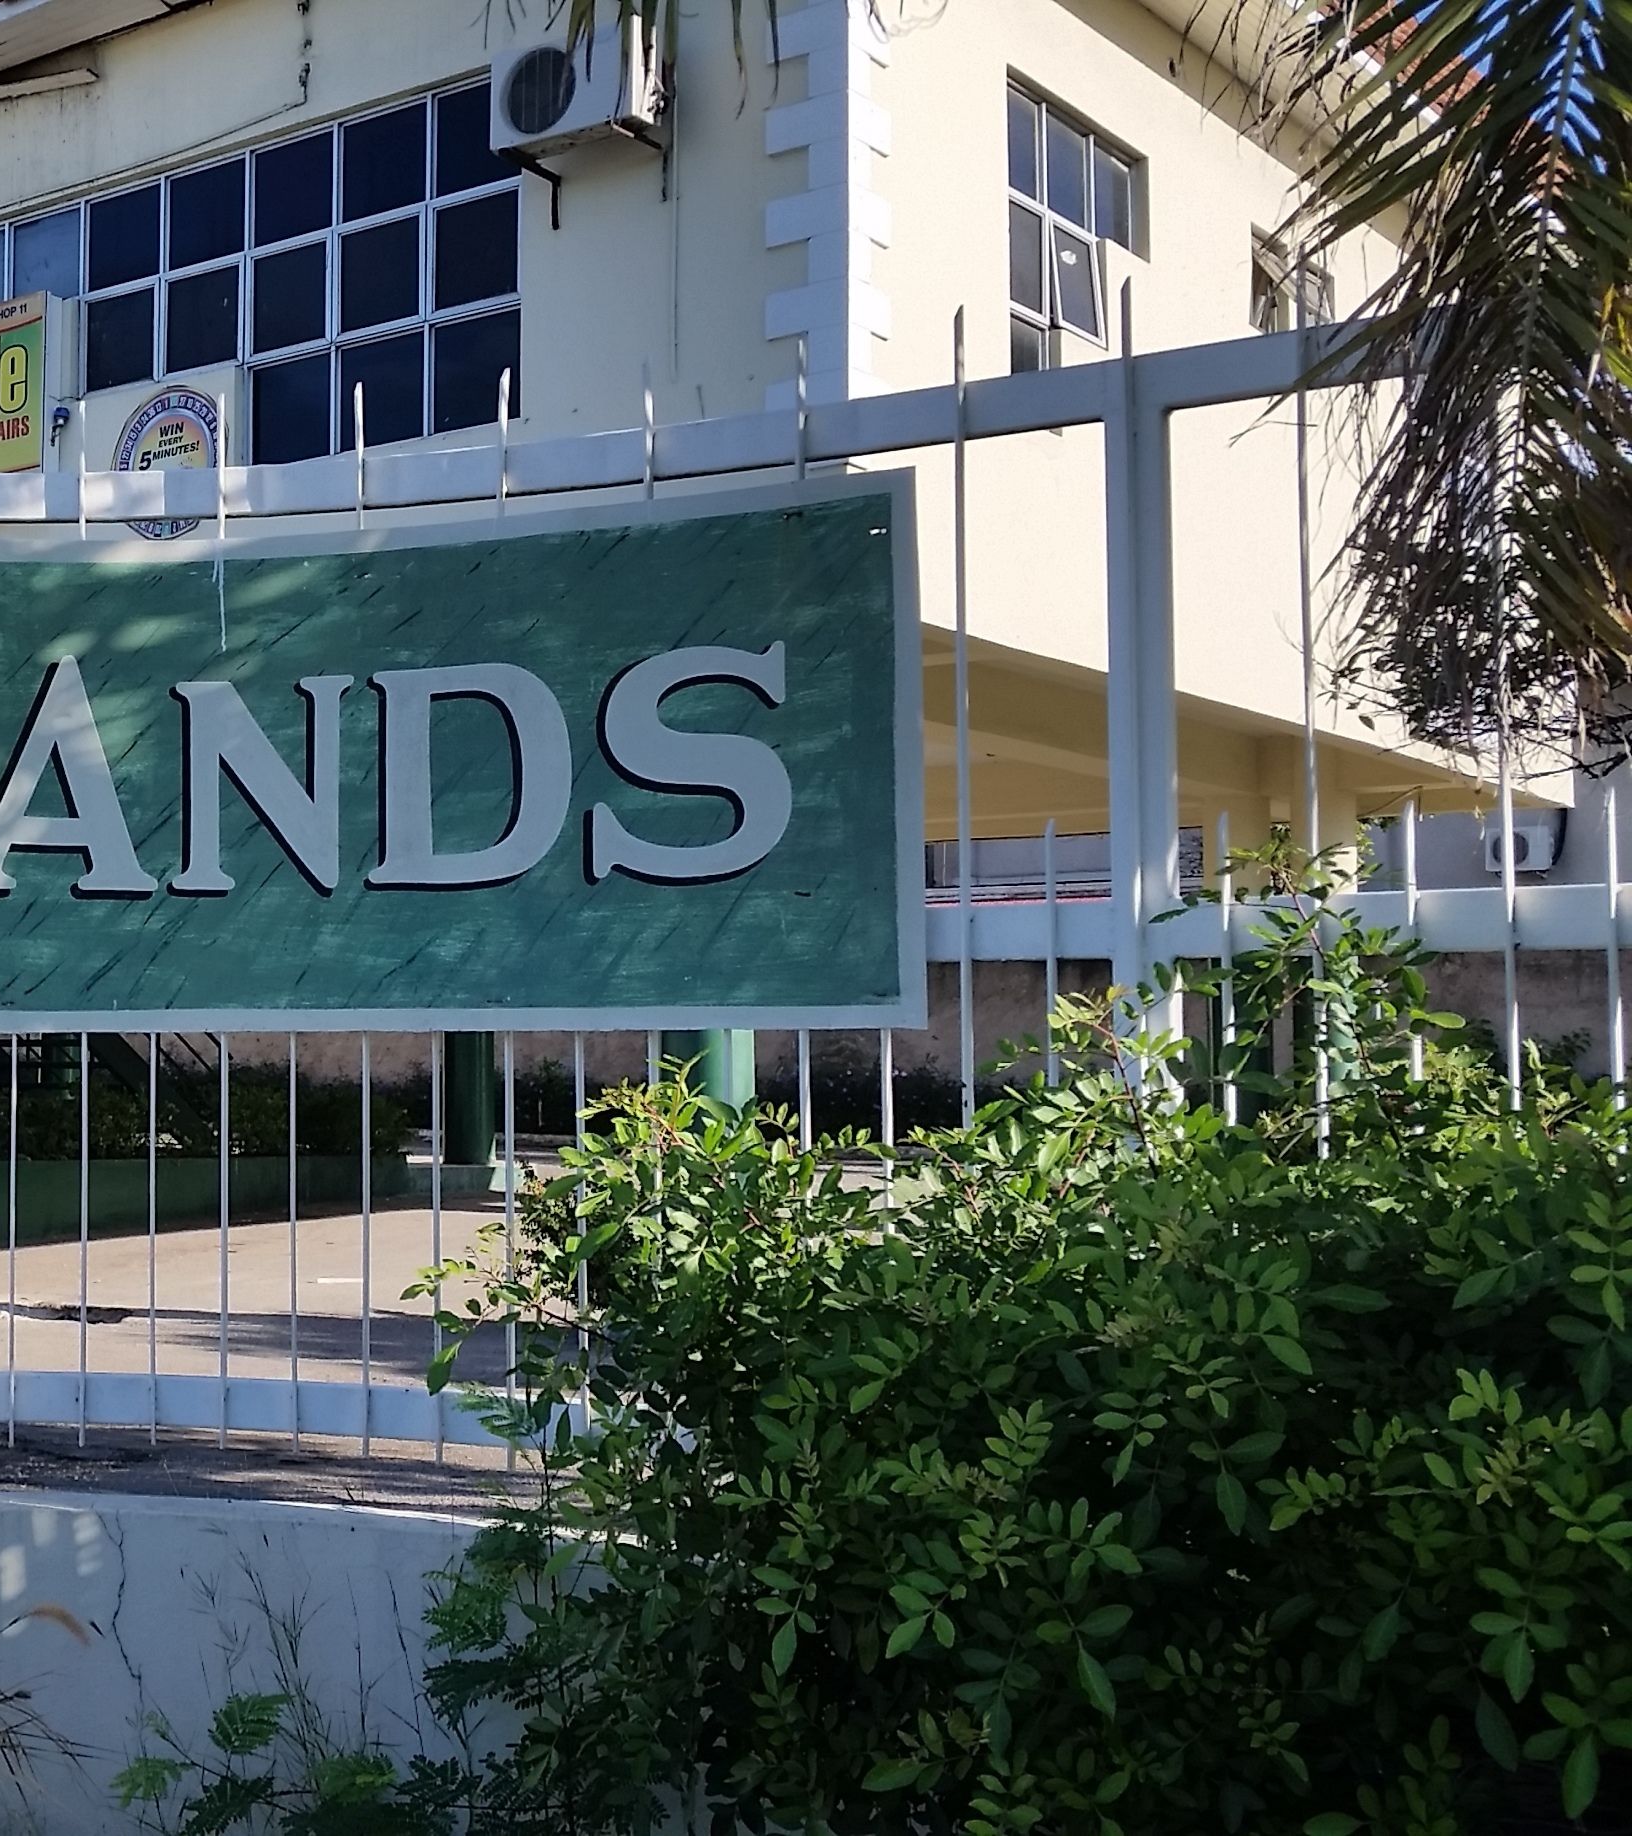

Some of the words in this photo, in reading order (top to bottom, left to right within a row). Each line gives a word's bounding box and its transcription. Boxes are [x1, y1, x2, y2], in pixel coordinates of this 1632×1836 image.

[19, 303, 27, 314] 11
[159, 422, 184, 438] WIN
[158, 435, 183, 448] EVERY
[139, 450, 152, 471] 5
[152, 440, 200, 461] MINUTES!
